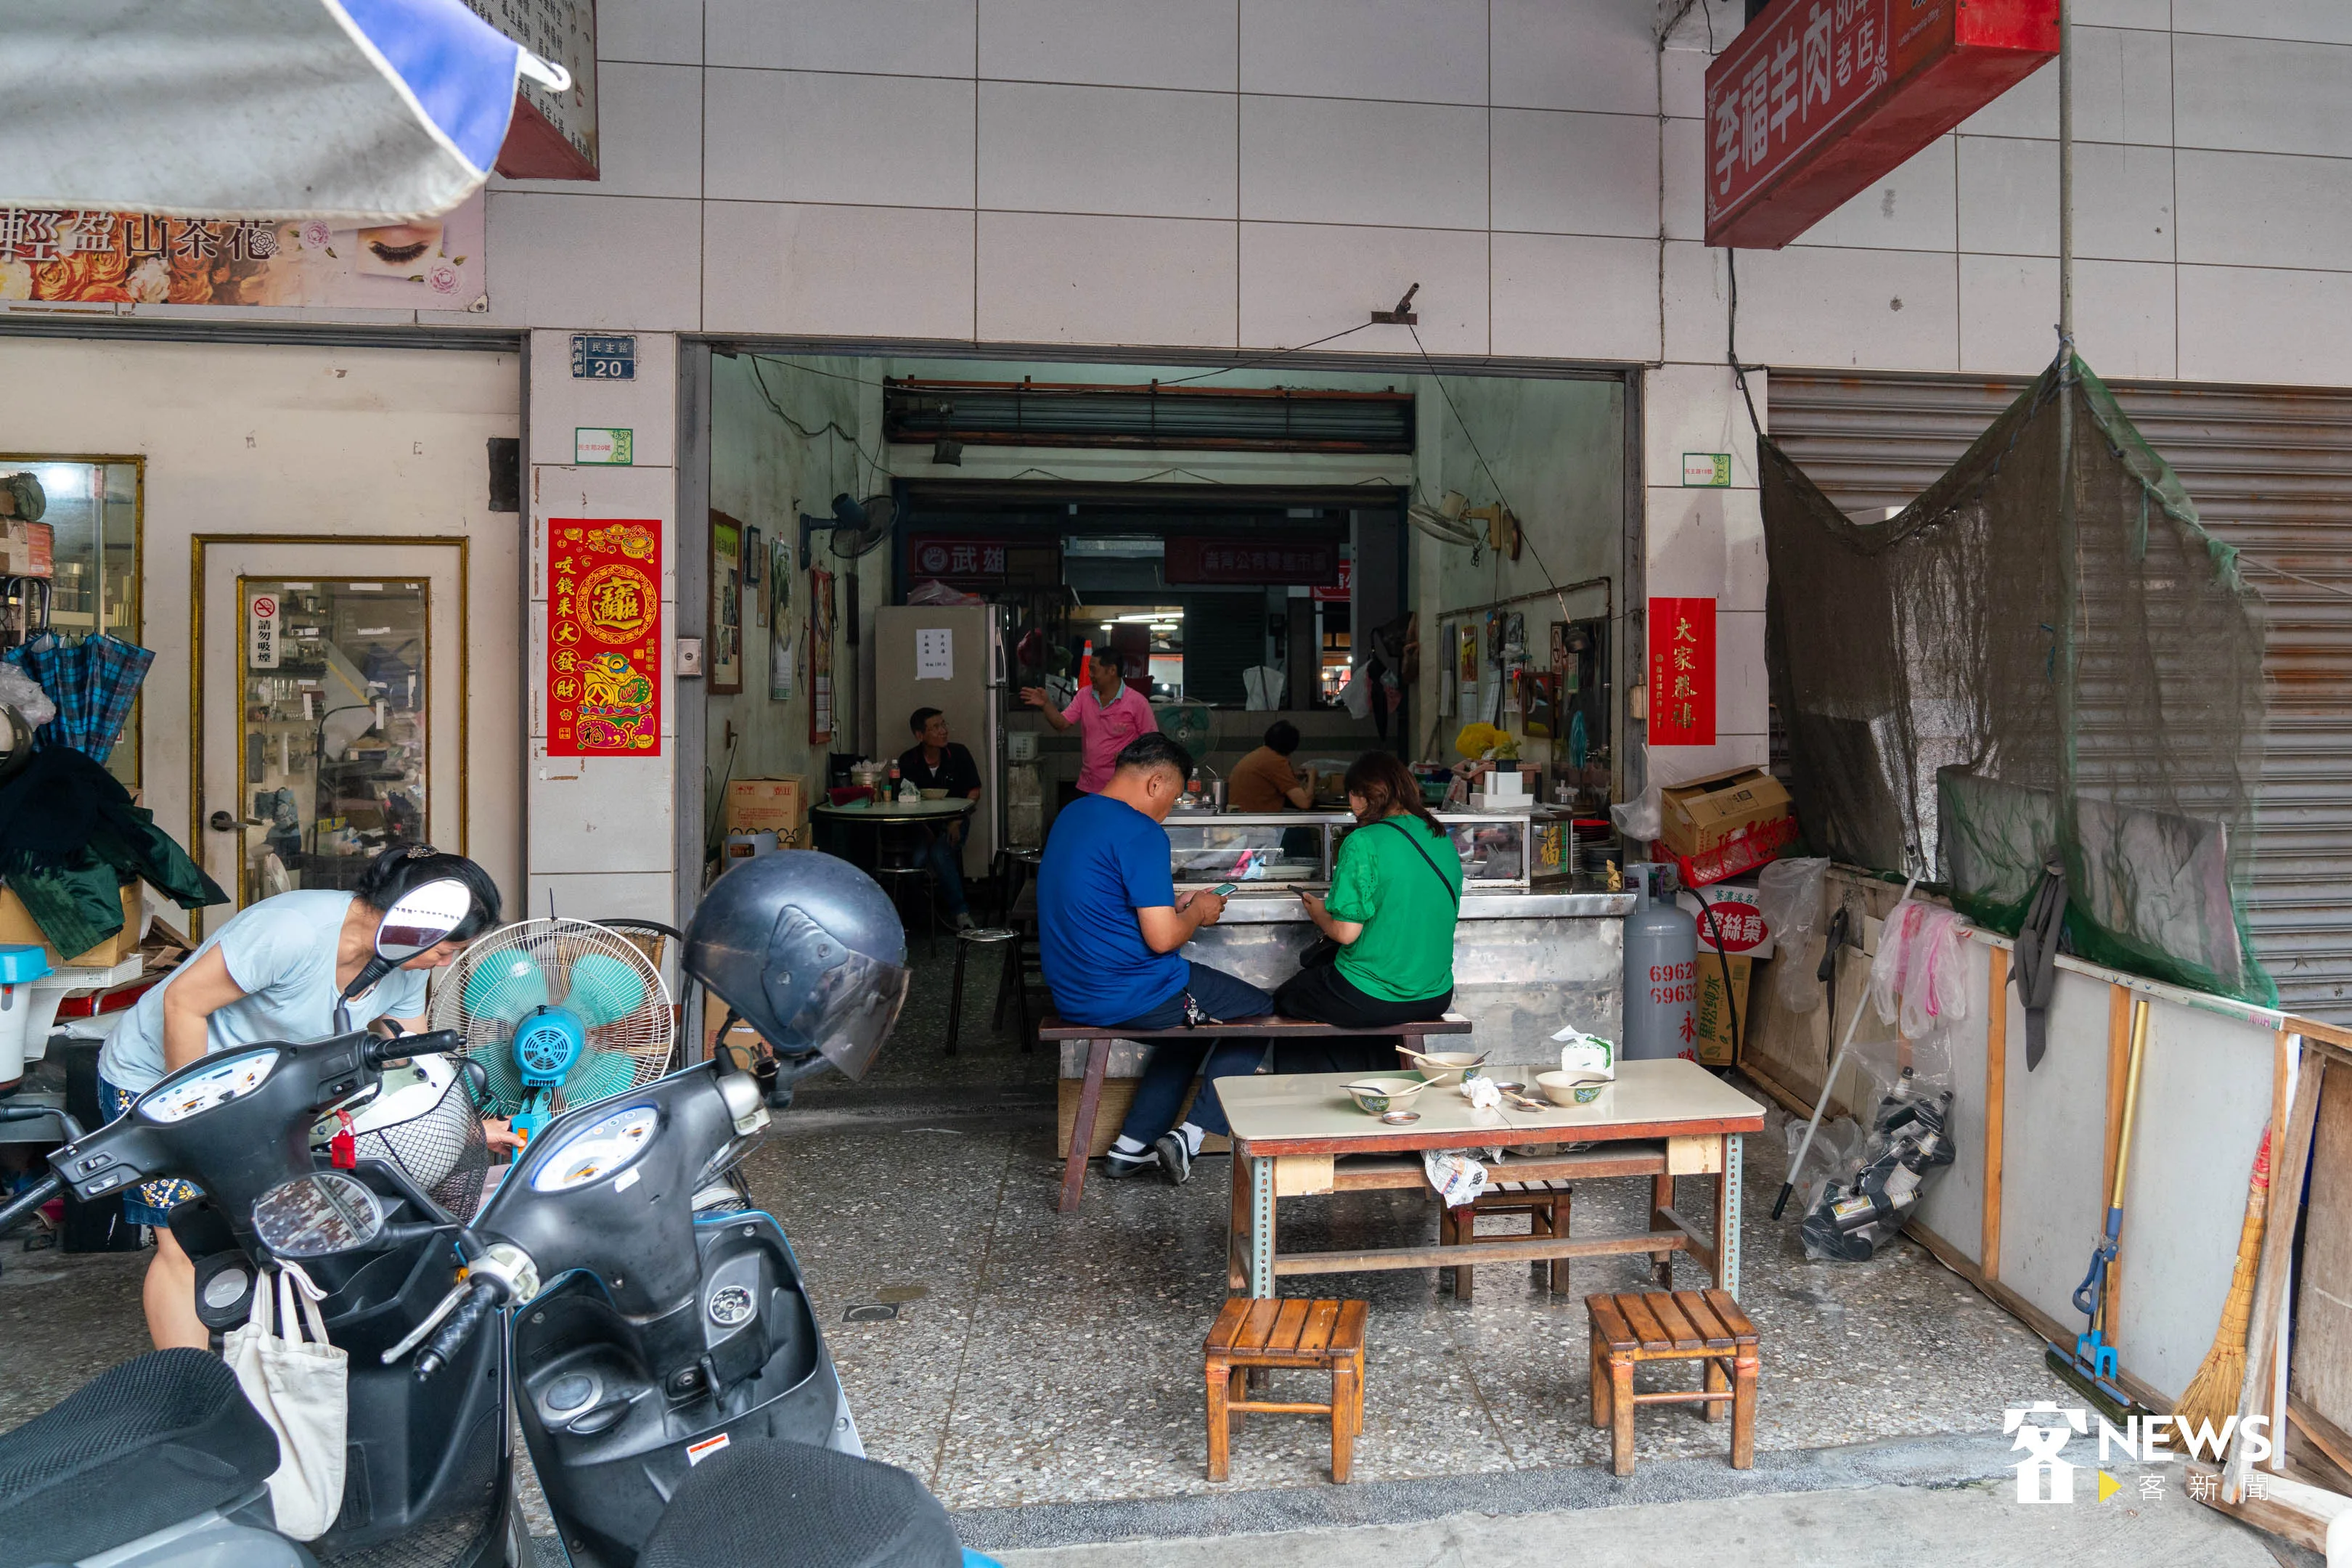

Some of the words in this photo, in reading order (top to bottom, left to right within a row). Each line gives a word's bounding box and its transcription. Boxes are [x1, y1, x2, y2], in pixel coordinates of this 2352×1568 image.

[1836, 18, 1874, 87] 老店
[1715, 4, 1832, 195] 李福羊肉
[572, 340, 583, 375] 崙背鄉
[592, 342, 628, 354] 民主路
[595, 361, 622, 377] 20
[258, 620, 271, 663] 請勿吸煙
[1672, 617, 1698, 729] 大家恭禧
[1702, 910, 1762, 943] 蜜絲棗
[1699, 973, 1720, 1042] 黑松純水
